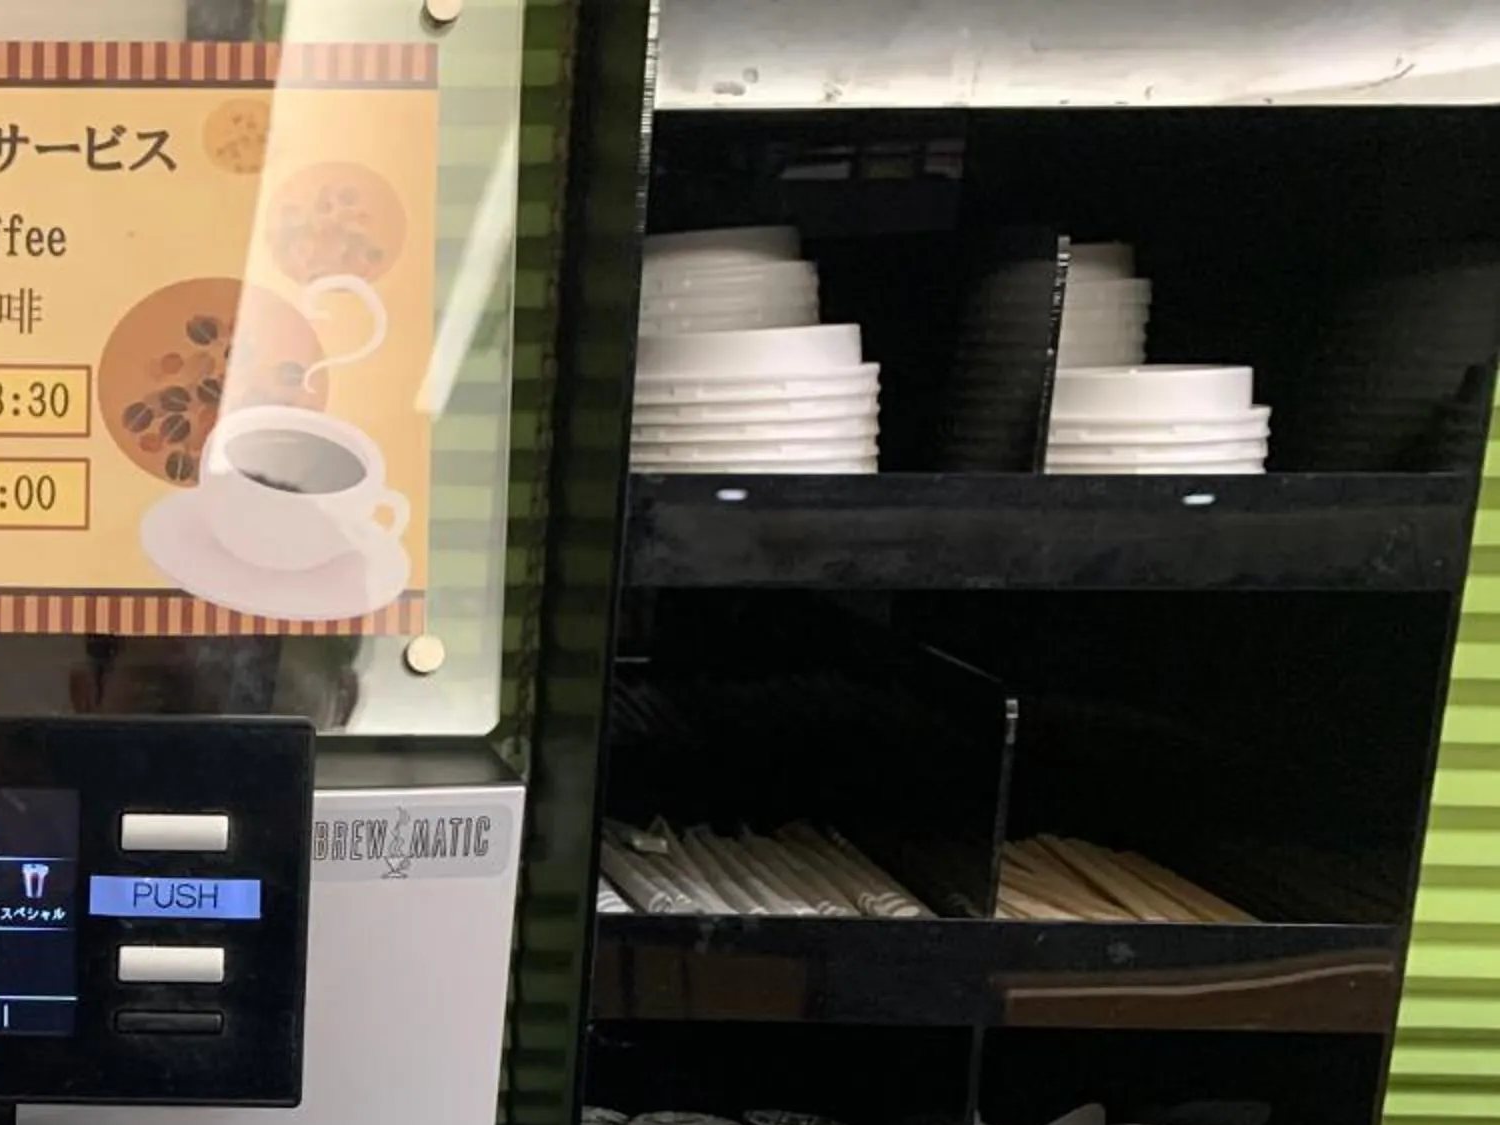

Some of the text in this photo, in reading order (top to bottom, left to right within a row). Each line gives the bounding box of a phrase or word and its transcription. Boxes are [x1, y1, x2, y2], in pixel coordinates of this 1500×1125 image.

[313, 815, 491, 861] BREW MATIC
[132, 882, 219, 911] PUSH
[0, 906, 67, 922] スペシャル
